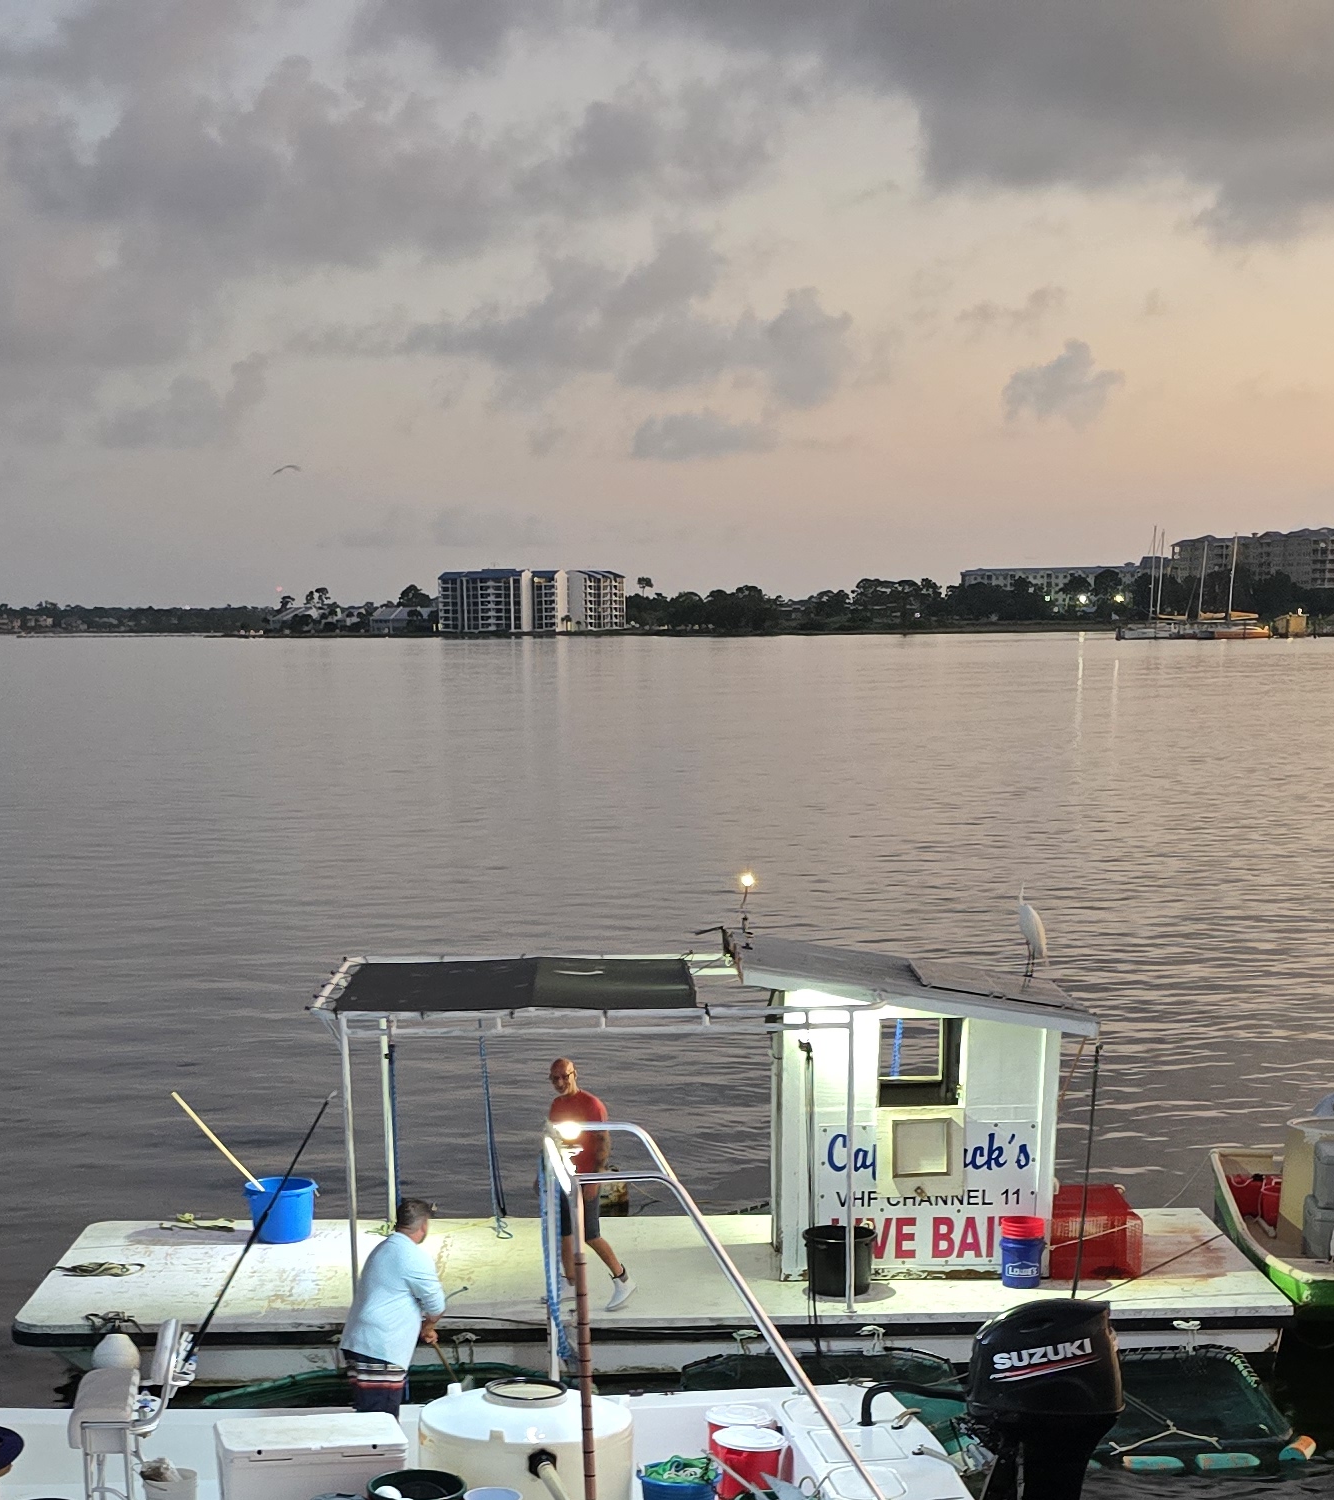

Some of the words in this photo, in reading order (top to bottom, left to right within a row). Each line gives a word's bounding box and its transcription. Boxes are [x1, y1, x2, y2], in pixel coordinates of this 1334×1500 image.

[835, 1190, 878, 1208] VHF
[1001, 1188, 1021, 1205] 11
[831, 1217, 917, 1259] VE
[931, 1215, 1009, 1259] BAI
[992, 1337, 1092, 1370] SUZUKI
